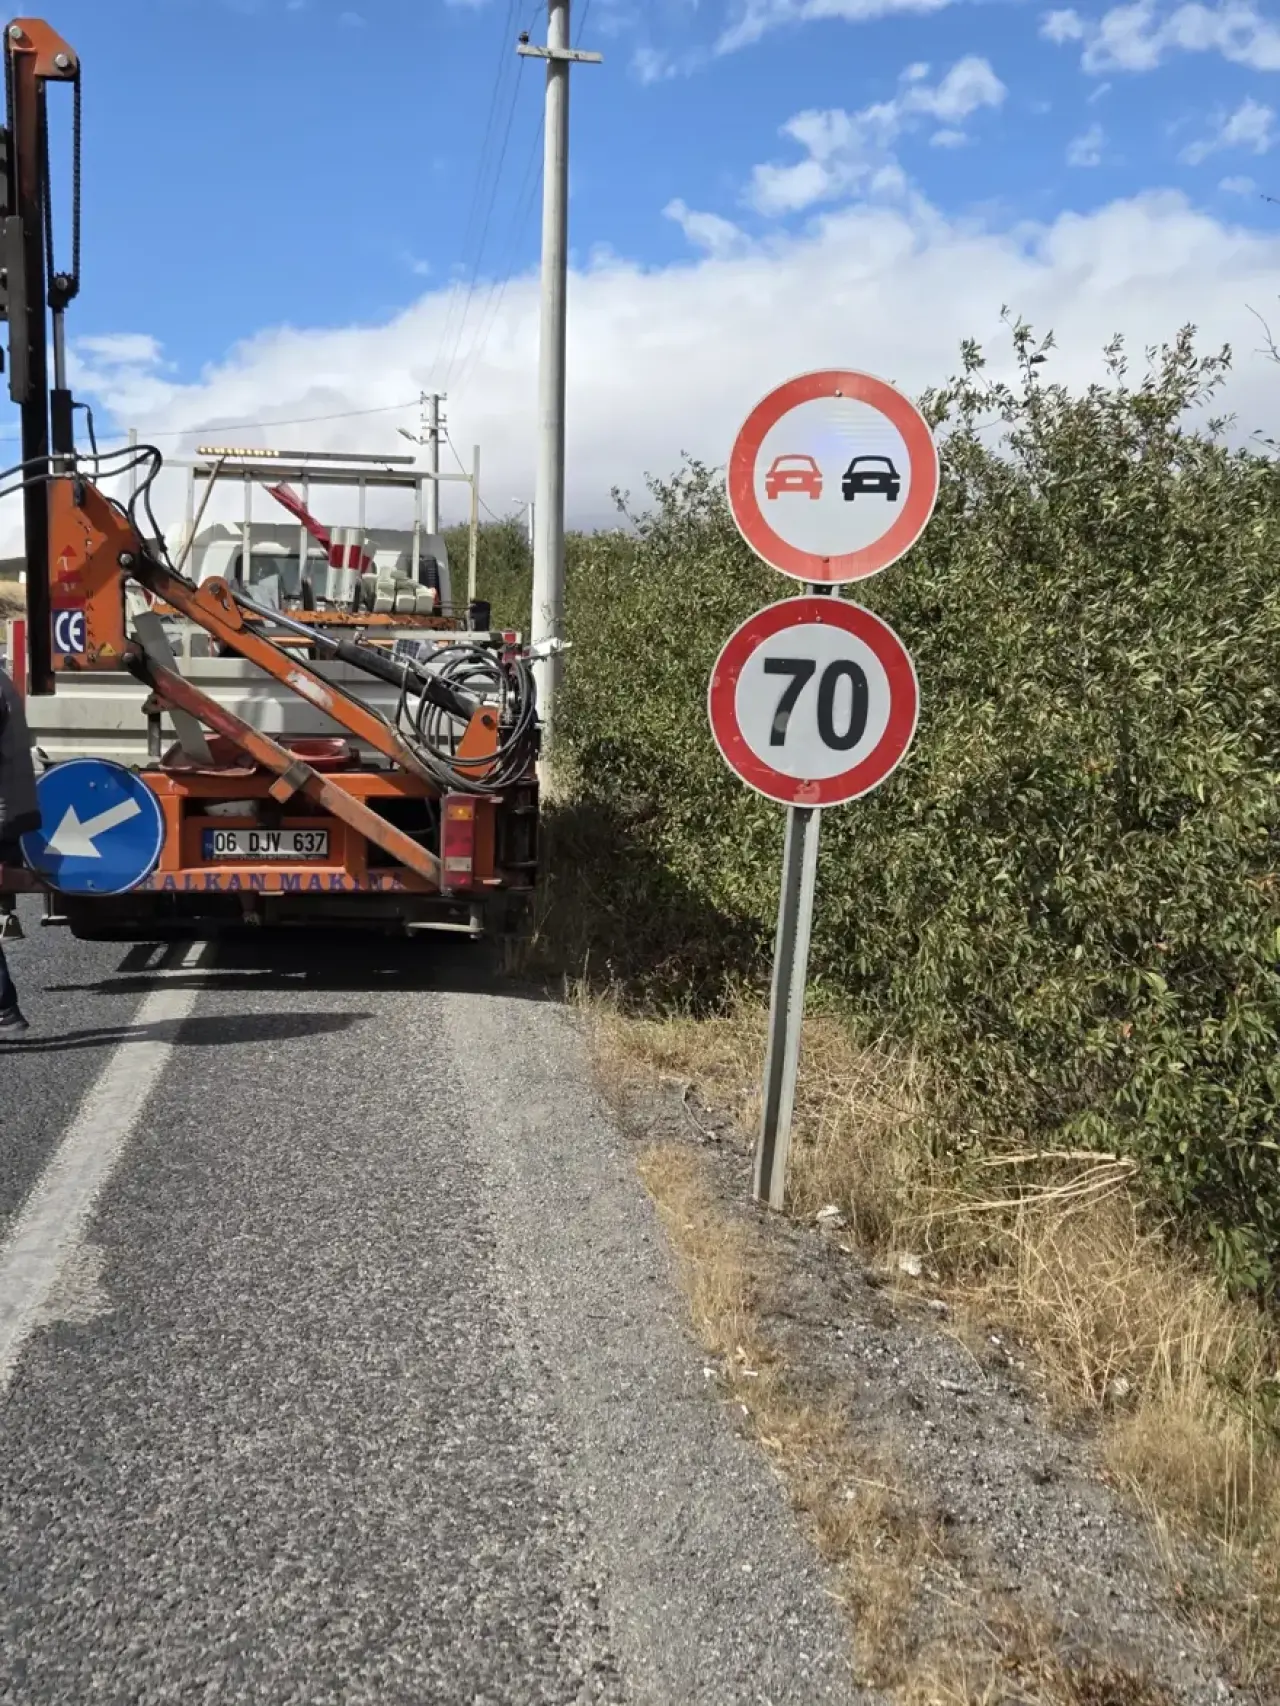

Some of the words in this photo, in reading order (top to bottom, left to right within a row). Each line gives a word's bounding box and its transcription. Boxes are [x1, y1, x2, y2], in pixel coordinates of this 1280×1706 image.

[54, 611, 83, 652] CE
[764, 657, 869, 751] 70
[216, 832, 237, 852] 06
[249, 832, 281, 852] DJV
[293, 832, 326, 852] 637
